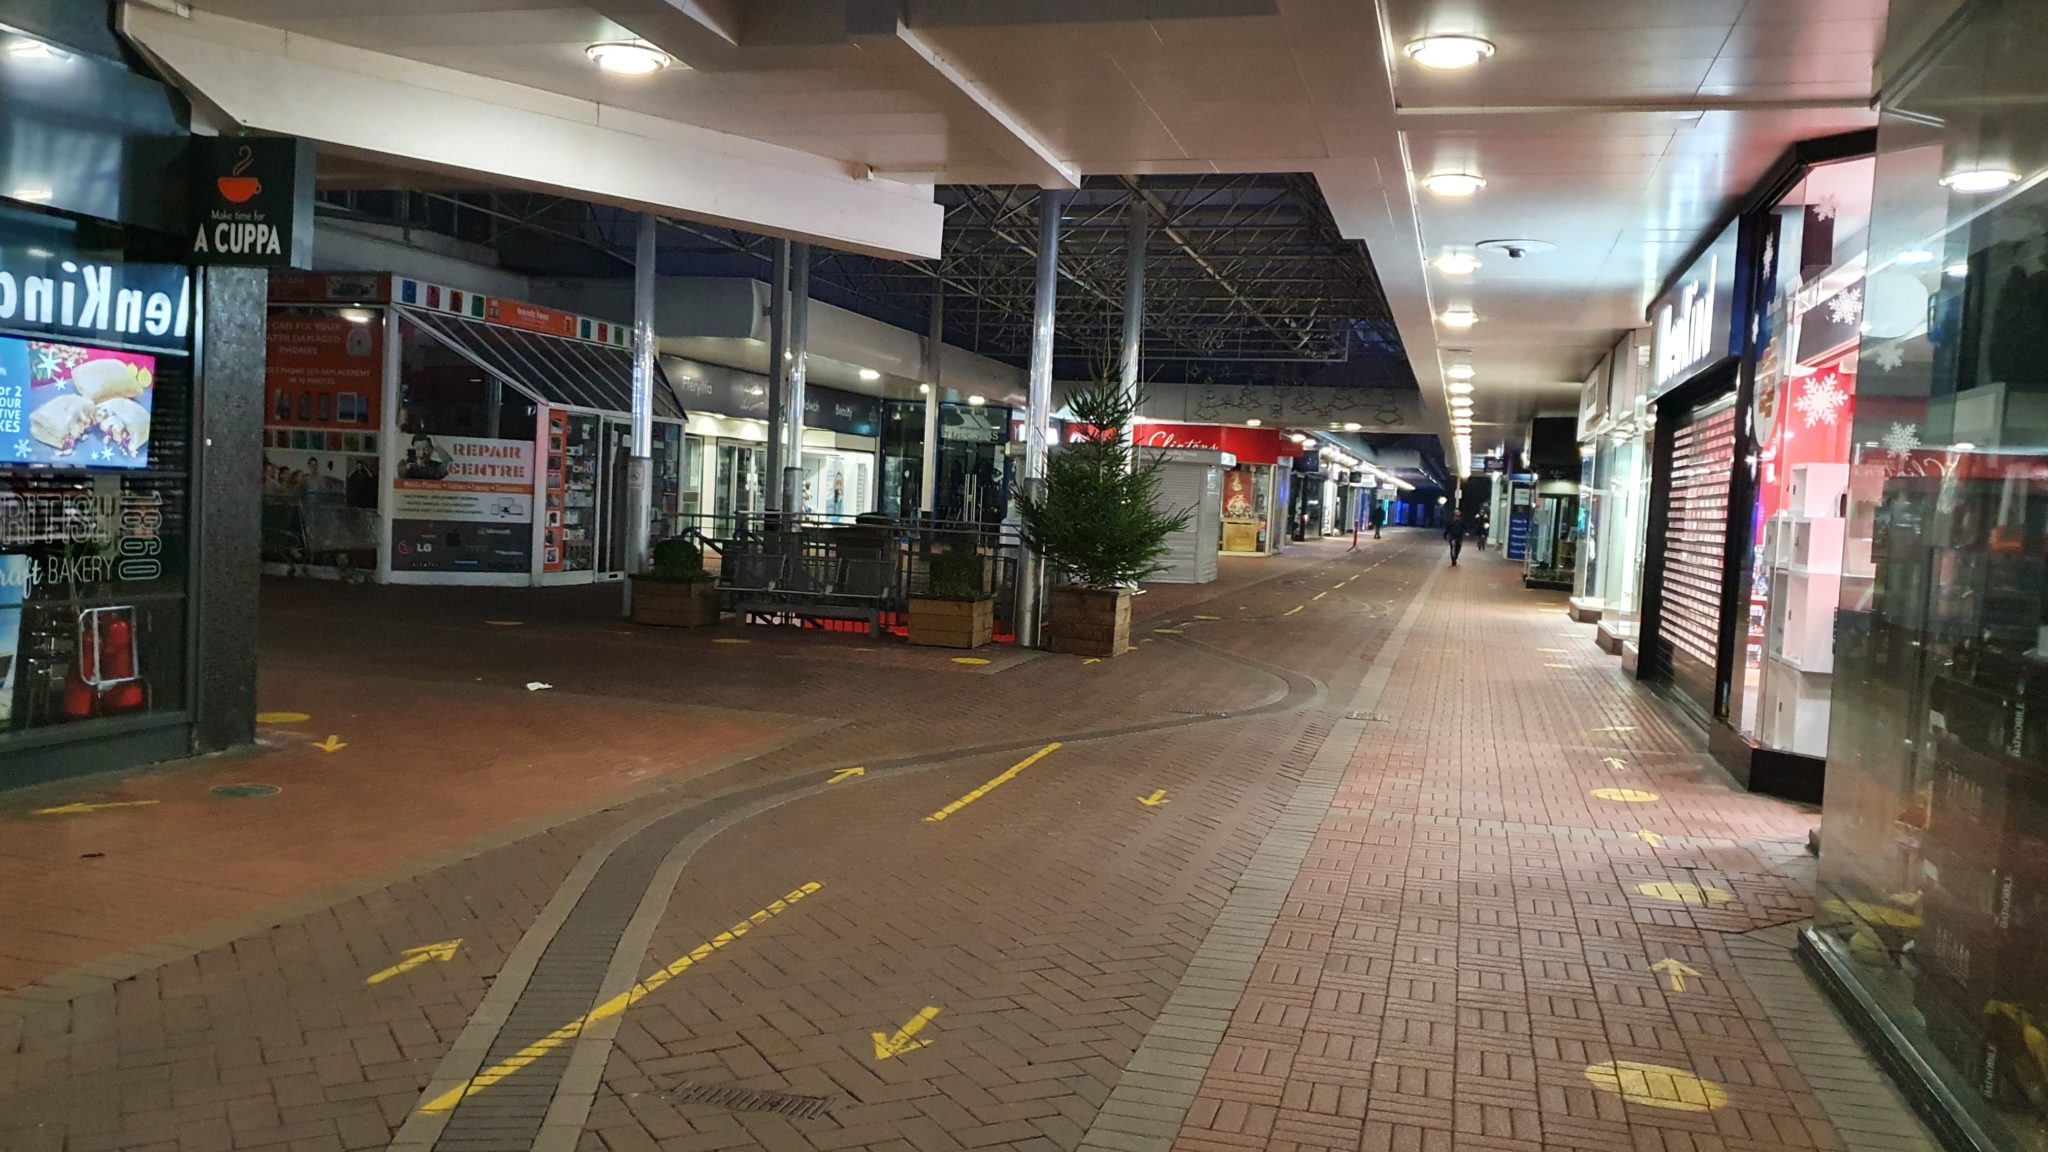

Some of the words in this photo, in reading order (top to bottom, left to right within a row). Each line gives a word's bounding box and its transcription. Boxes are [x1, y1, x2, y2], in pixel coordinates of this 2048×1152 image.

[211, 209, 234, 221] Make
[235, 210, 252, 221] time
[253, 210, 265, 221] for
[194, 222, 208, 253] A
[215, 223, 281, 255] CUPPA
[14, 385, 22, 397] 2
[453, 443, 521, 459] REPAIR
[448, 462, 525, 478] CENTRE
[416, 543, 432, 552] LG
[48, 556, 115, 584] BAKERY
